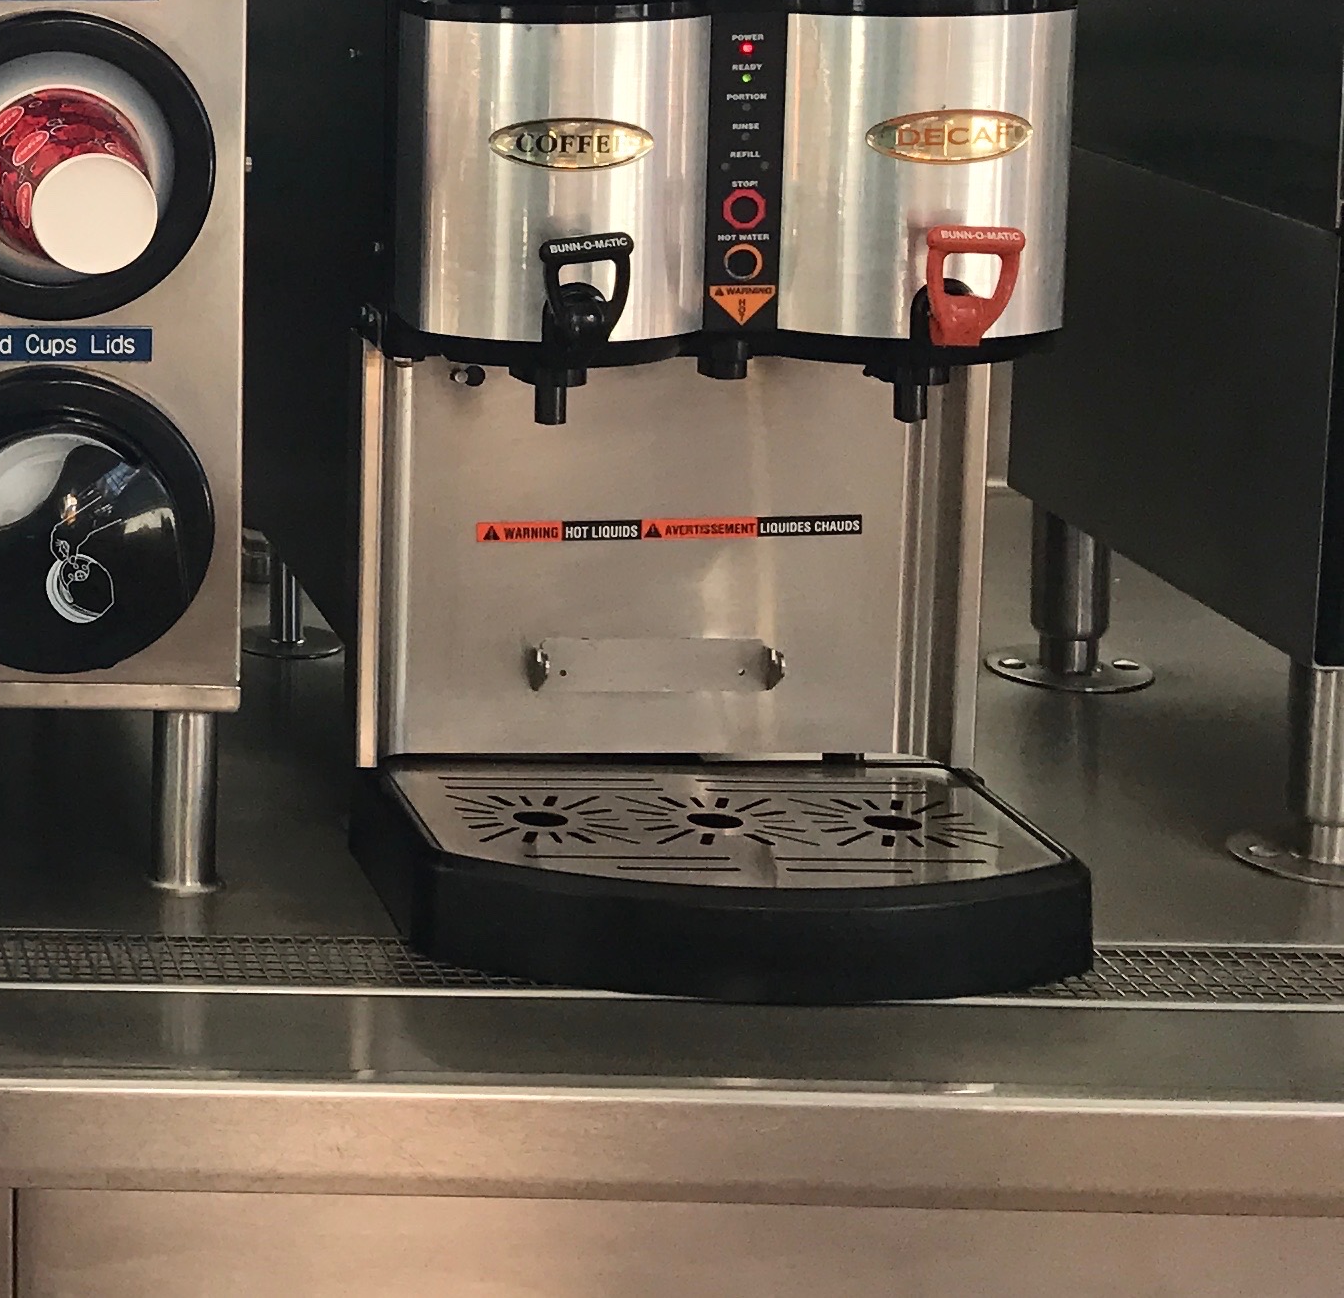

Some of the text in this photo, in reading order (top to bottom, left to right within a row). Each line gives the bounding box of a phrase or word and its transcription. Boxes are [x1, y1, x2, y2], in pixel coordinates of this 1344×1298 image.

[731, 33, 764, 41] POWER
[731, 63, 763, 71] READY
[726, 93, 768, 101] PORTION
[732, 122, 760, 130] RINSE
[515, 133, 632, 154] COFFE
[739, 233, 770, 241] WATER
[940, 230, 1021, 241] BUNN-O-MATIC
[549, 237, 628, 254] BUNN-O-MATIC
[25, 333, 77, 356] Cups
[90, 333, 136, 354] Lids
[503, 519, 861, 540] WARNING HOT LIQUIDS AVERTISSEMENT LIQUIDES CHAUDS
